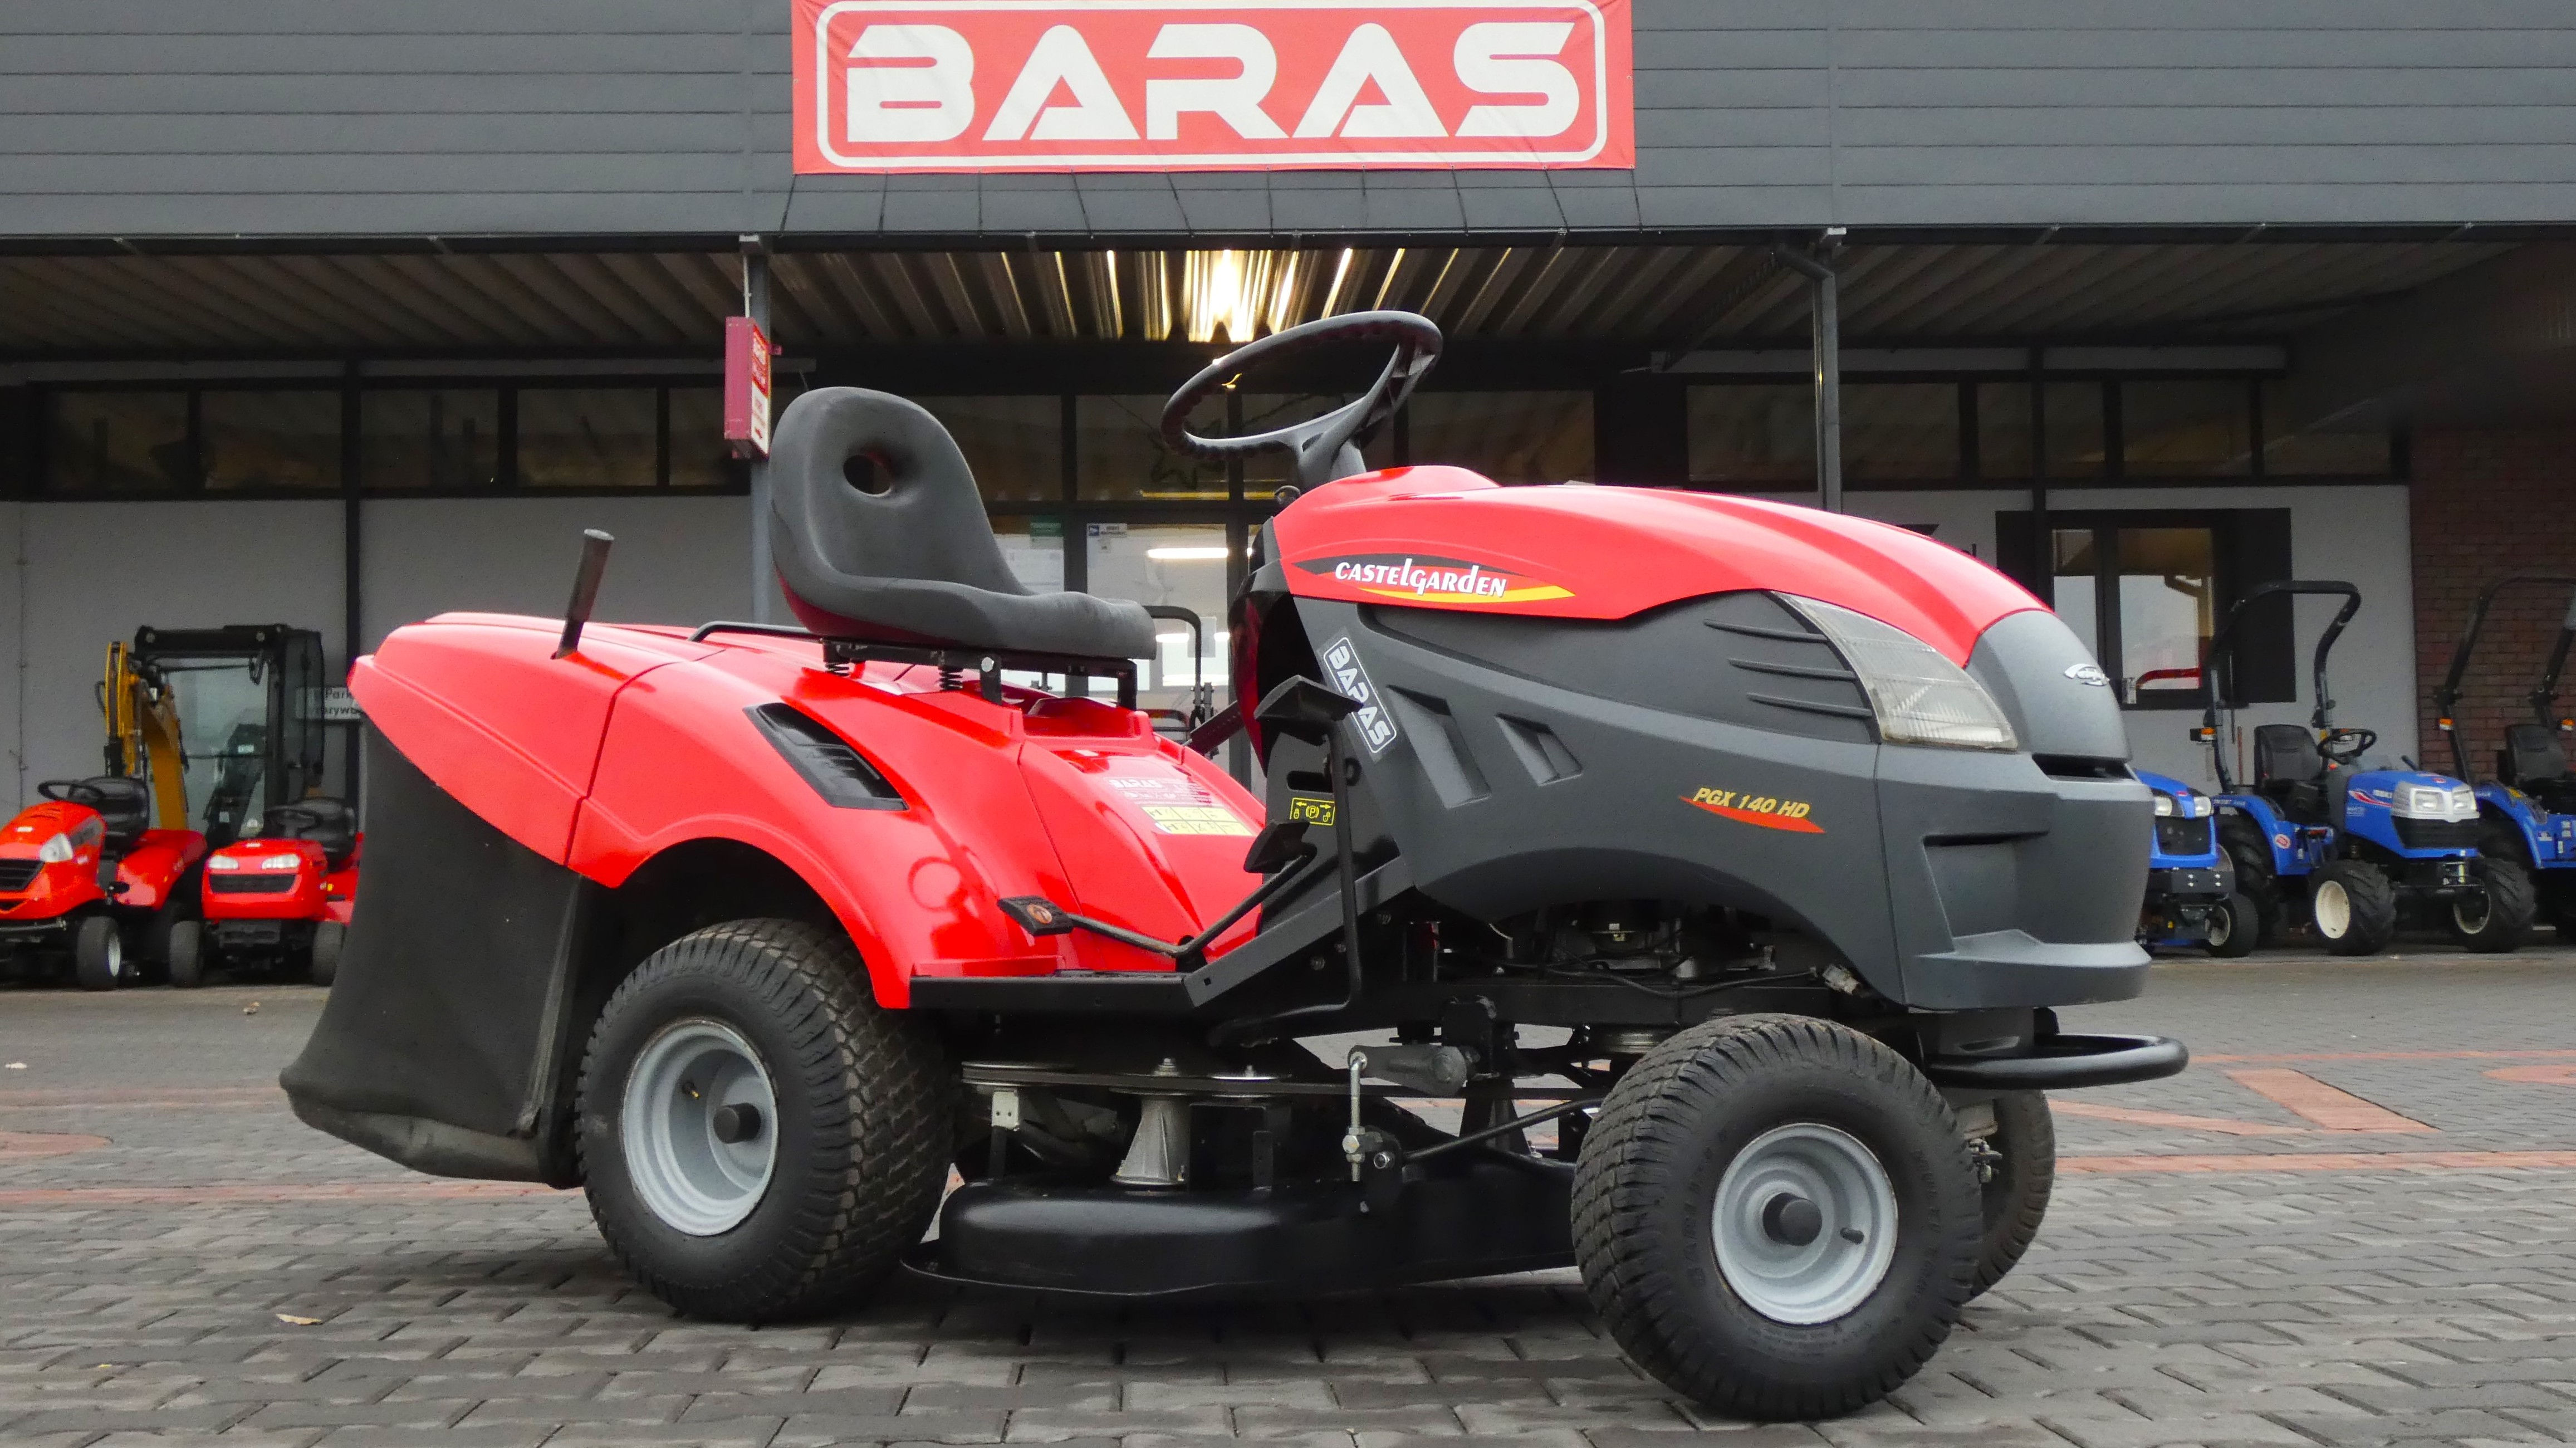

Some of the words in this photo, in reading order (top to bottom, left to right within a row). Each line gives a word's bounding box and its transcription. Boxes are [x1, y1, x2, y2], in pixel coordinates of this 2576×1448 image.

[846, 22, 1580, 143] BARAS
[1328, 645, 1391, 745] BARAS
[1692, 787, 1736, 808] PGX
[1738, 795, 1777, 814] 140
[1777, 800, 1811, 819] HD
